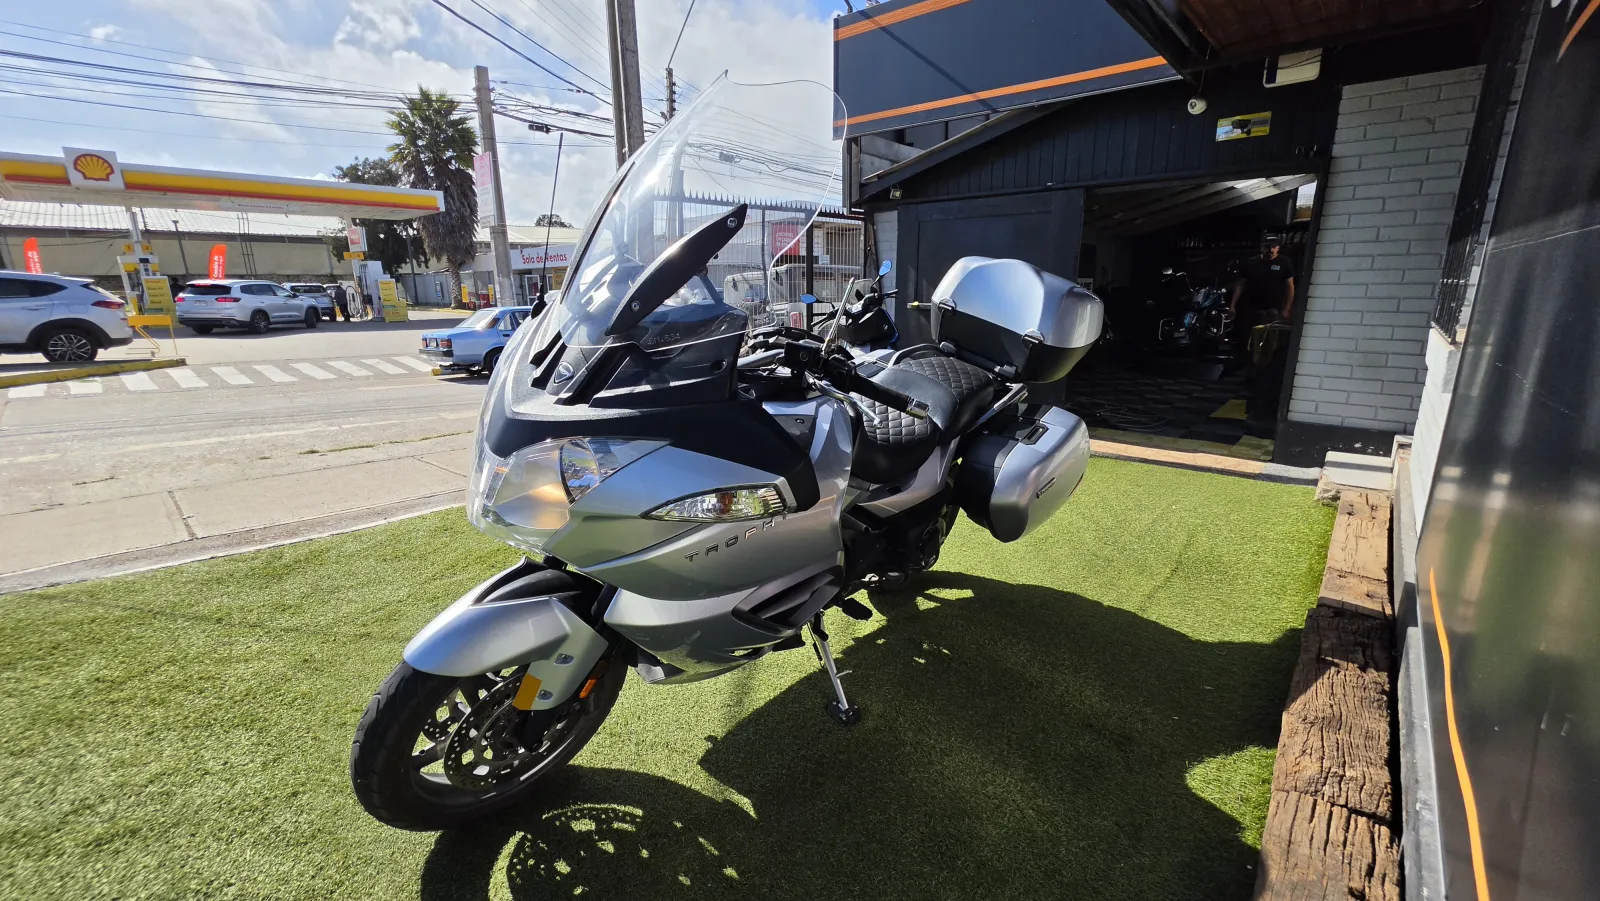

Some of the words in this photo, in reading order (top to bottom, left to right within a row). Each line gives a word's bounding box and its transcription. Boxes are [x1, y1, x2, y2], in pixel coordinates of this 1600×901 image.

[522, 252, 535, 264] Sala
[536, 252, 544, 263] de
[544, 252, 567, 263] Ventas
